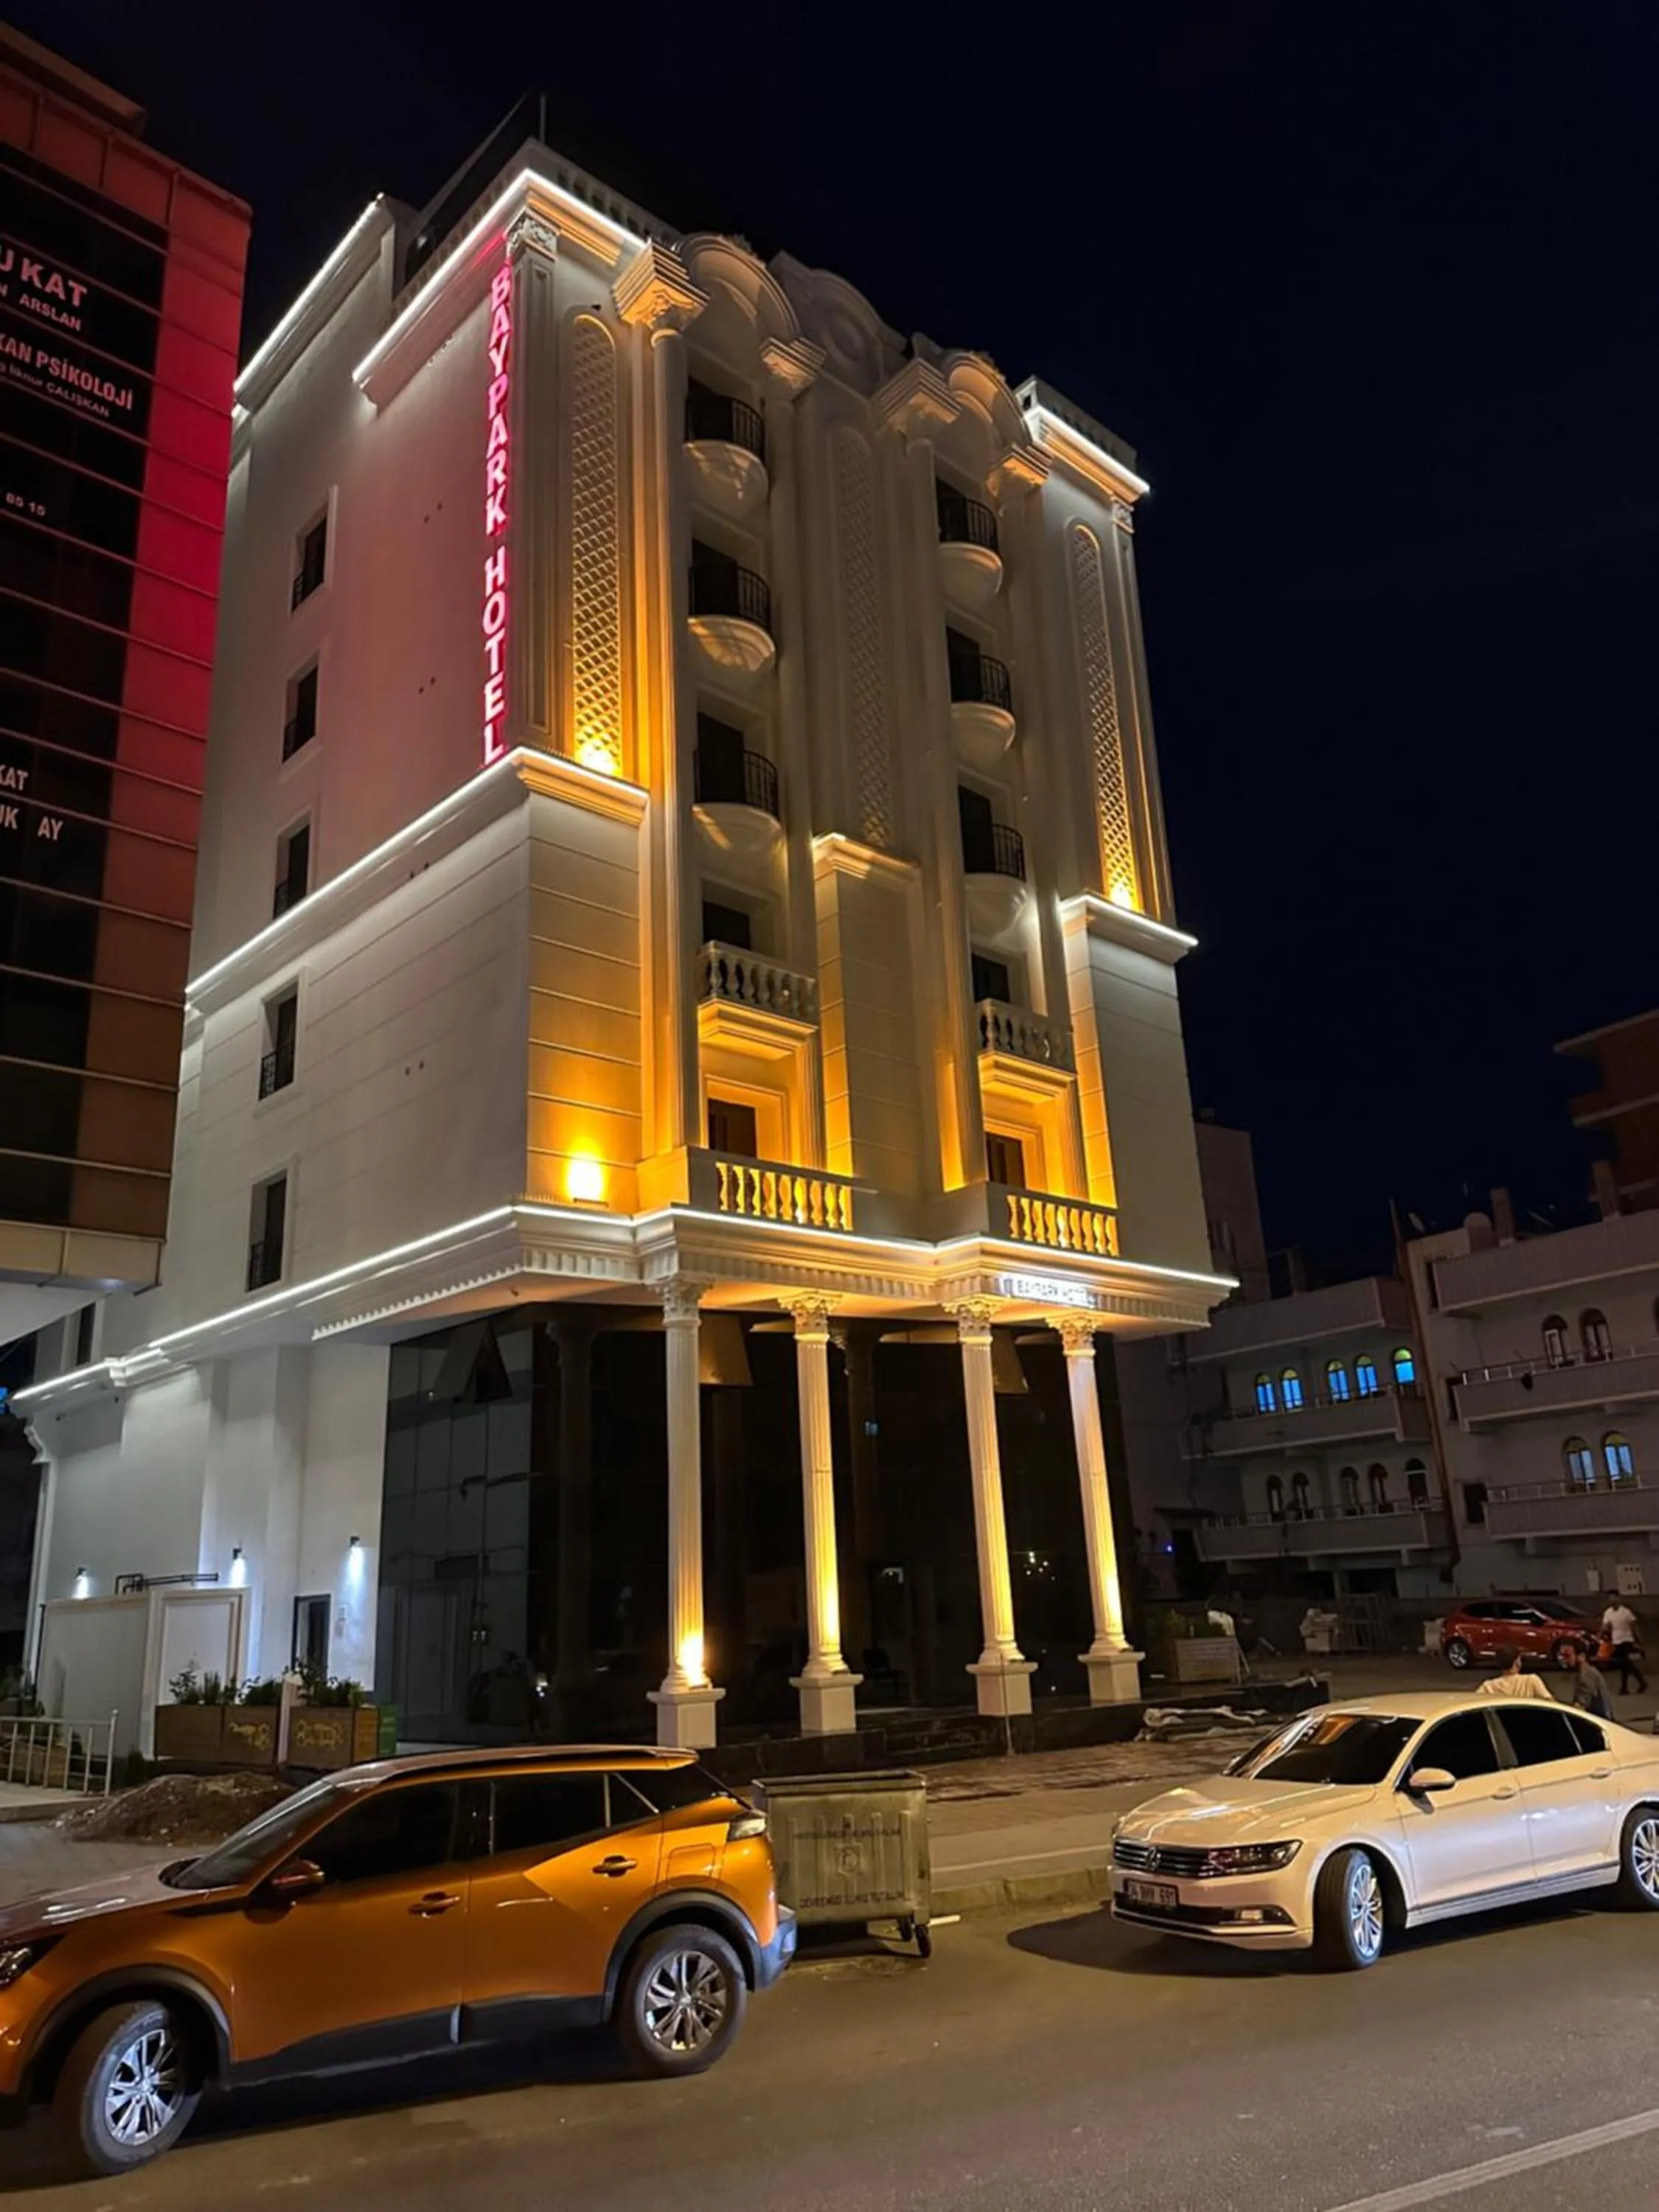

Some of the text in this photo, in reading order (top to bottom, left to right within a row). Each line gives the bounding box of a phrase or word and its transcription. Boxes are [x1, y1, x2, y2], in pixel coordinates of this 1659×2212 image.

[19, 293, 81, 331] ARSLAN
[483, 263, 511, 765] BAYPARK HOTEL
[37, 816, 64, 841] AY
